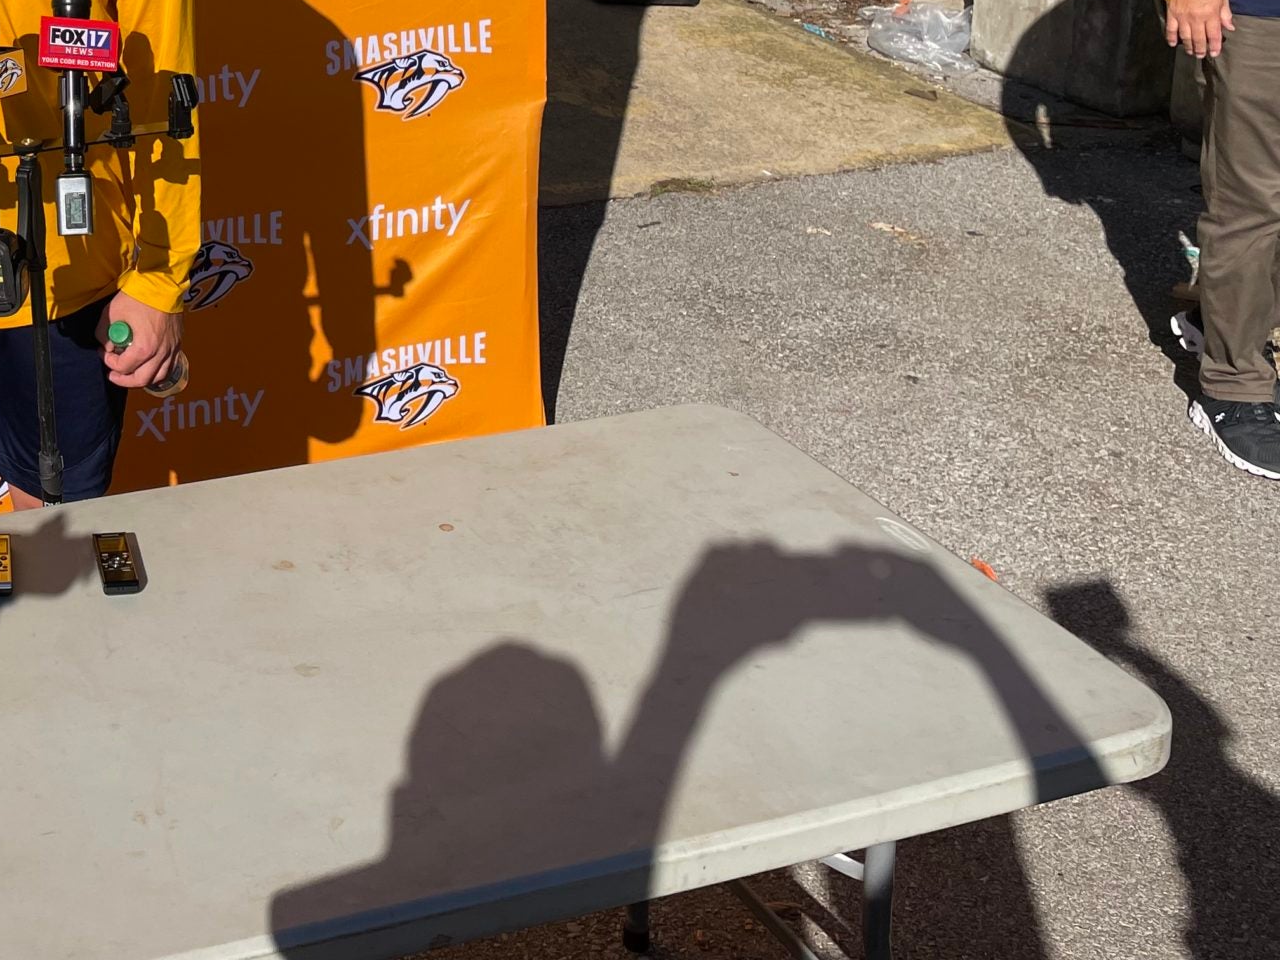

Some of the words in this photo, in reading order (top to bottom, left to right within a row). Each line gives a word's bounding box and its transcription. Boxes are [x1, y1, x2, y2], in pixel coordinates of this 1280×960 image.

[51, 27, 86, 46] FOX
[89, 30, 110, 47] 17
[65, 47, 94, 56] NEWS
[326, 17, 493, 75] SMASHVILLE
[42, 56, 59, 64] YOUR
[90, 60, 116, 68] STATION
[201, 210, 283, 245] VILLE
[347, 194, 472, 251] xfinity
[327, 330, 487, 392] SMASHVILLE
[135, 388, 265, 439] xfinity
